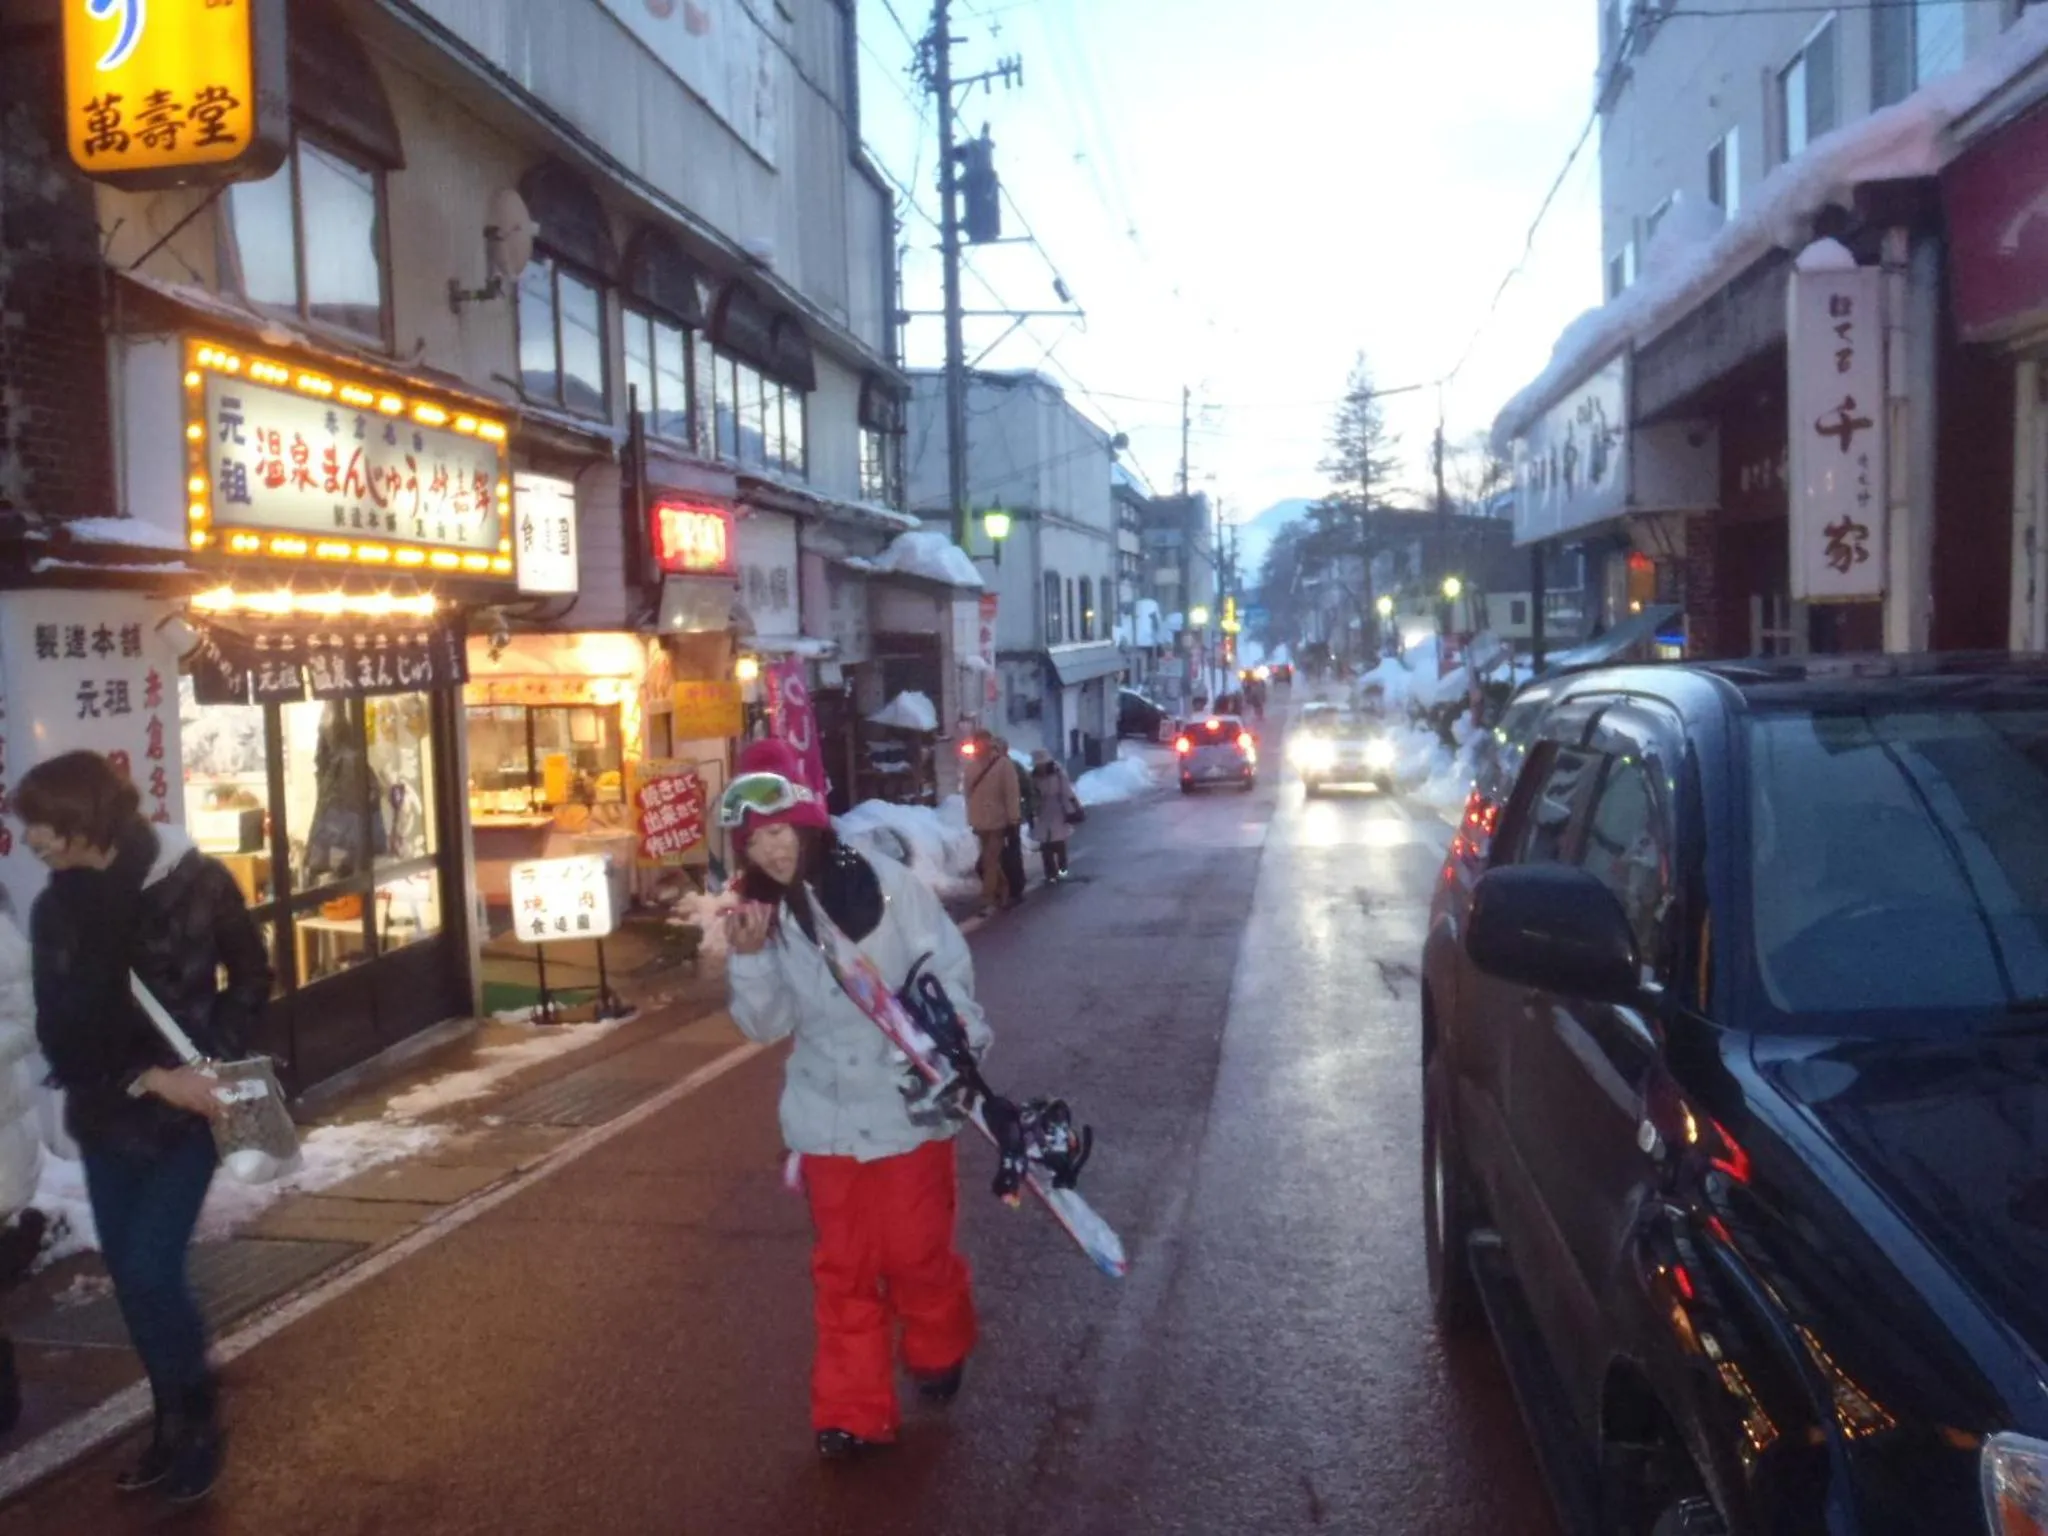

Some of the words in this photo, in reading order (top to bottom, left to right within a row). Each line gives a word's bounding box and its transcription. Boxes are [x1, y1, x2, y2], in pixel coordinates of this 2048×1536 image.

[82, 85, 241, 157] 萬壽堂
[208, 397, 252, 505] 元祖
[35, 622, 143, 660] 製造本舗
[76, 680, 132, 719] 元祖
